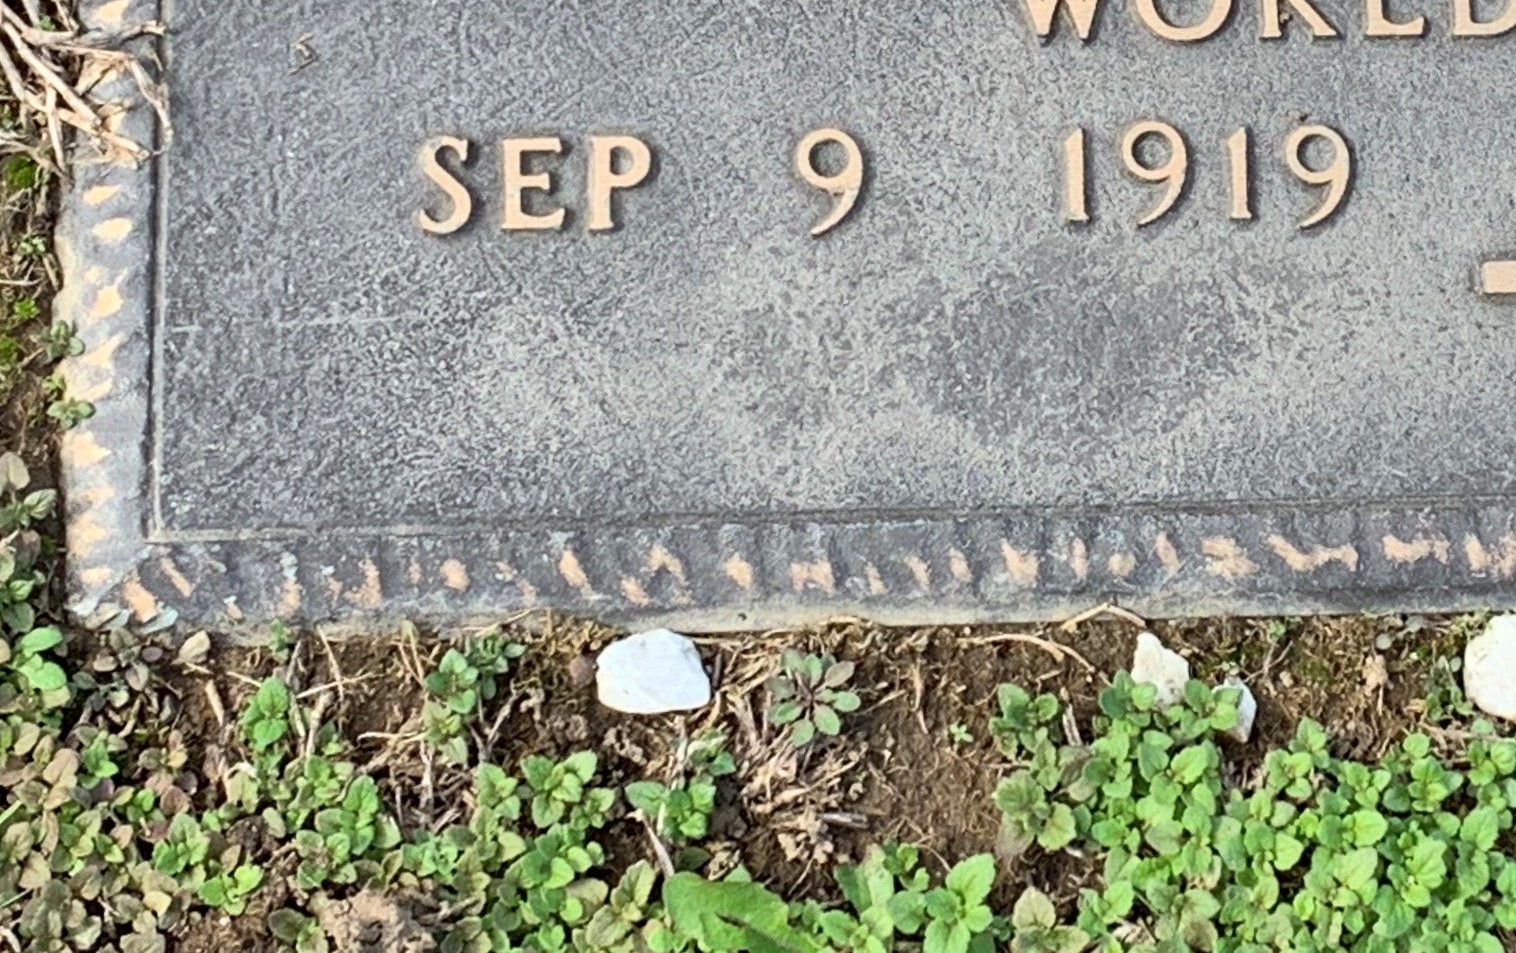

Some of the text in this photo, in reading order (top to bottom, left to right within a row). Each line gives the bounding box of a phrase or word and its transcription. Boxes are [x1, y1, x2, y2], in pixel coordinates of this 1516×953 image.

[416, 132, 655, 235] SEP
[793, 126, 867, 237] 9
[1061, 118, 1354, 230] 1919
